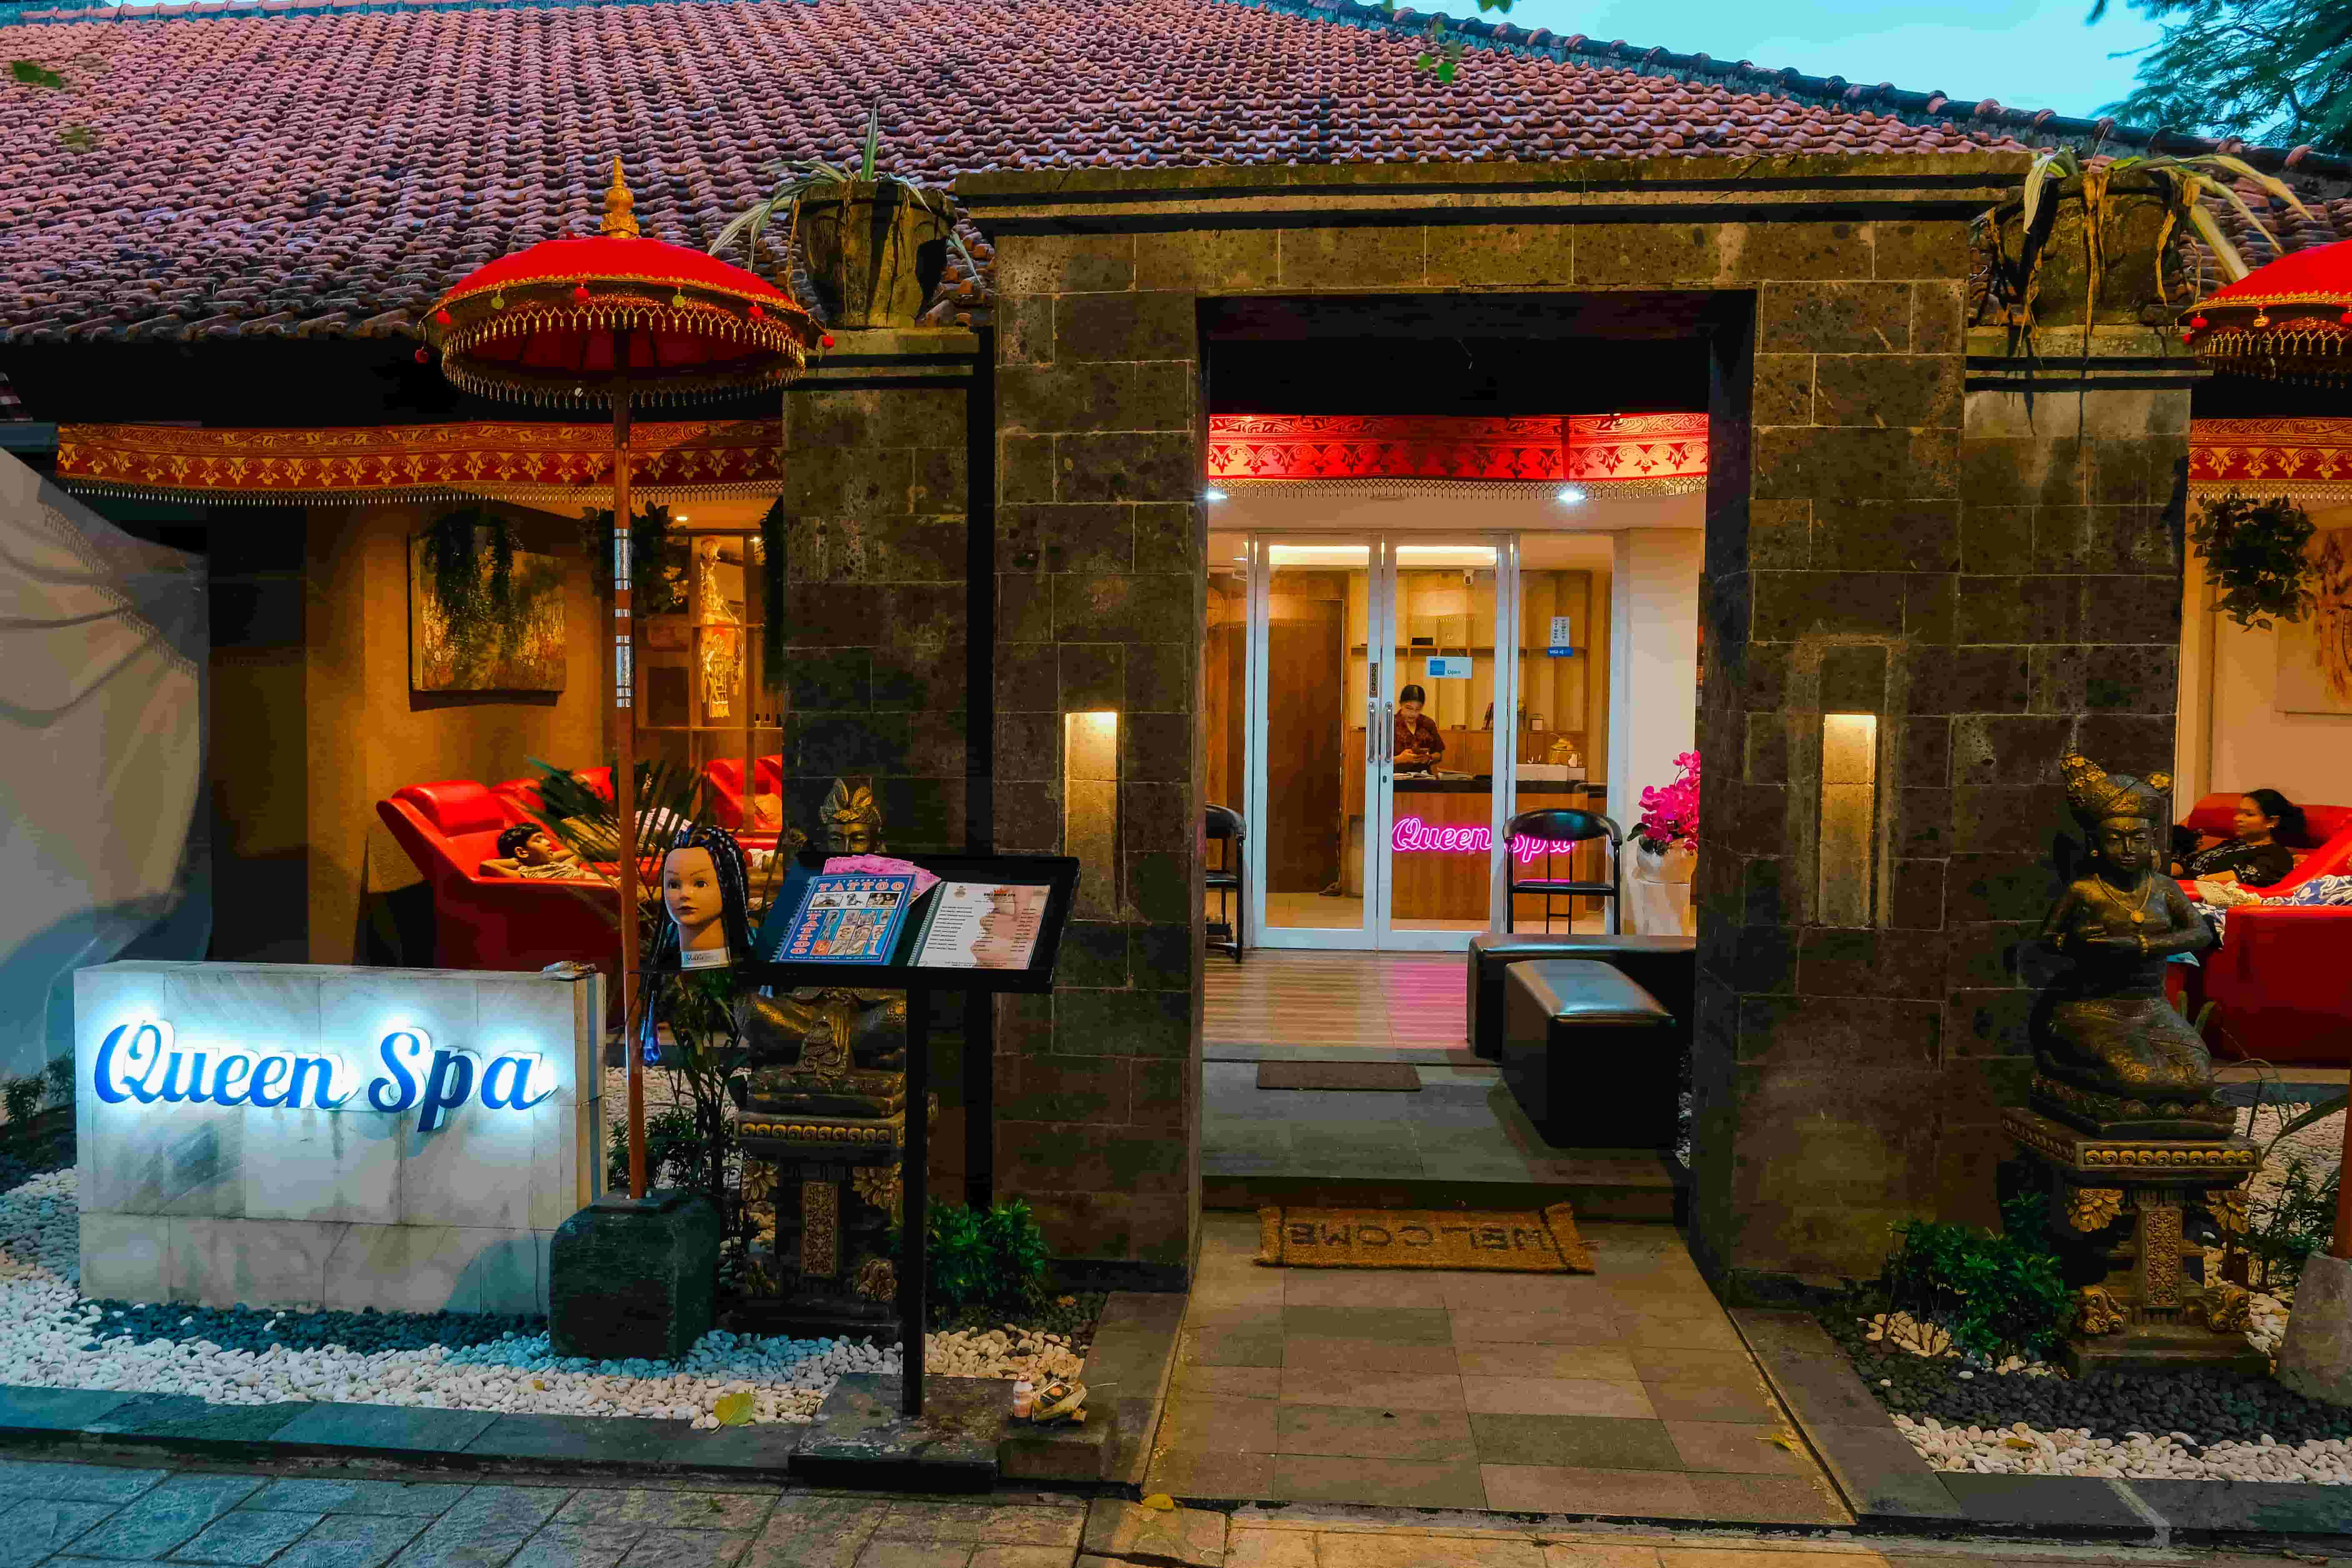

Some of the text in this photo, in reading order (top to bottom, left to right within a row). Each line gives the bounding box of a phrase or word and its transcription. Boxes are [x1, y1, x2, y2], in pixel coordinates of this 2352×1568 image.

[1392, 818, 1492, 851] Queen
[820, 881, 905, 891] TATTOO
[790, 913, 822, 954] TATTOO
[94, 1019, 559, 1133] Queen Spa
[1289, 1222, 1547, 1250] WELCOME
